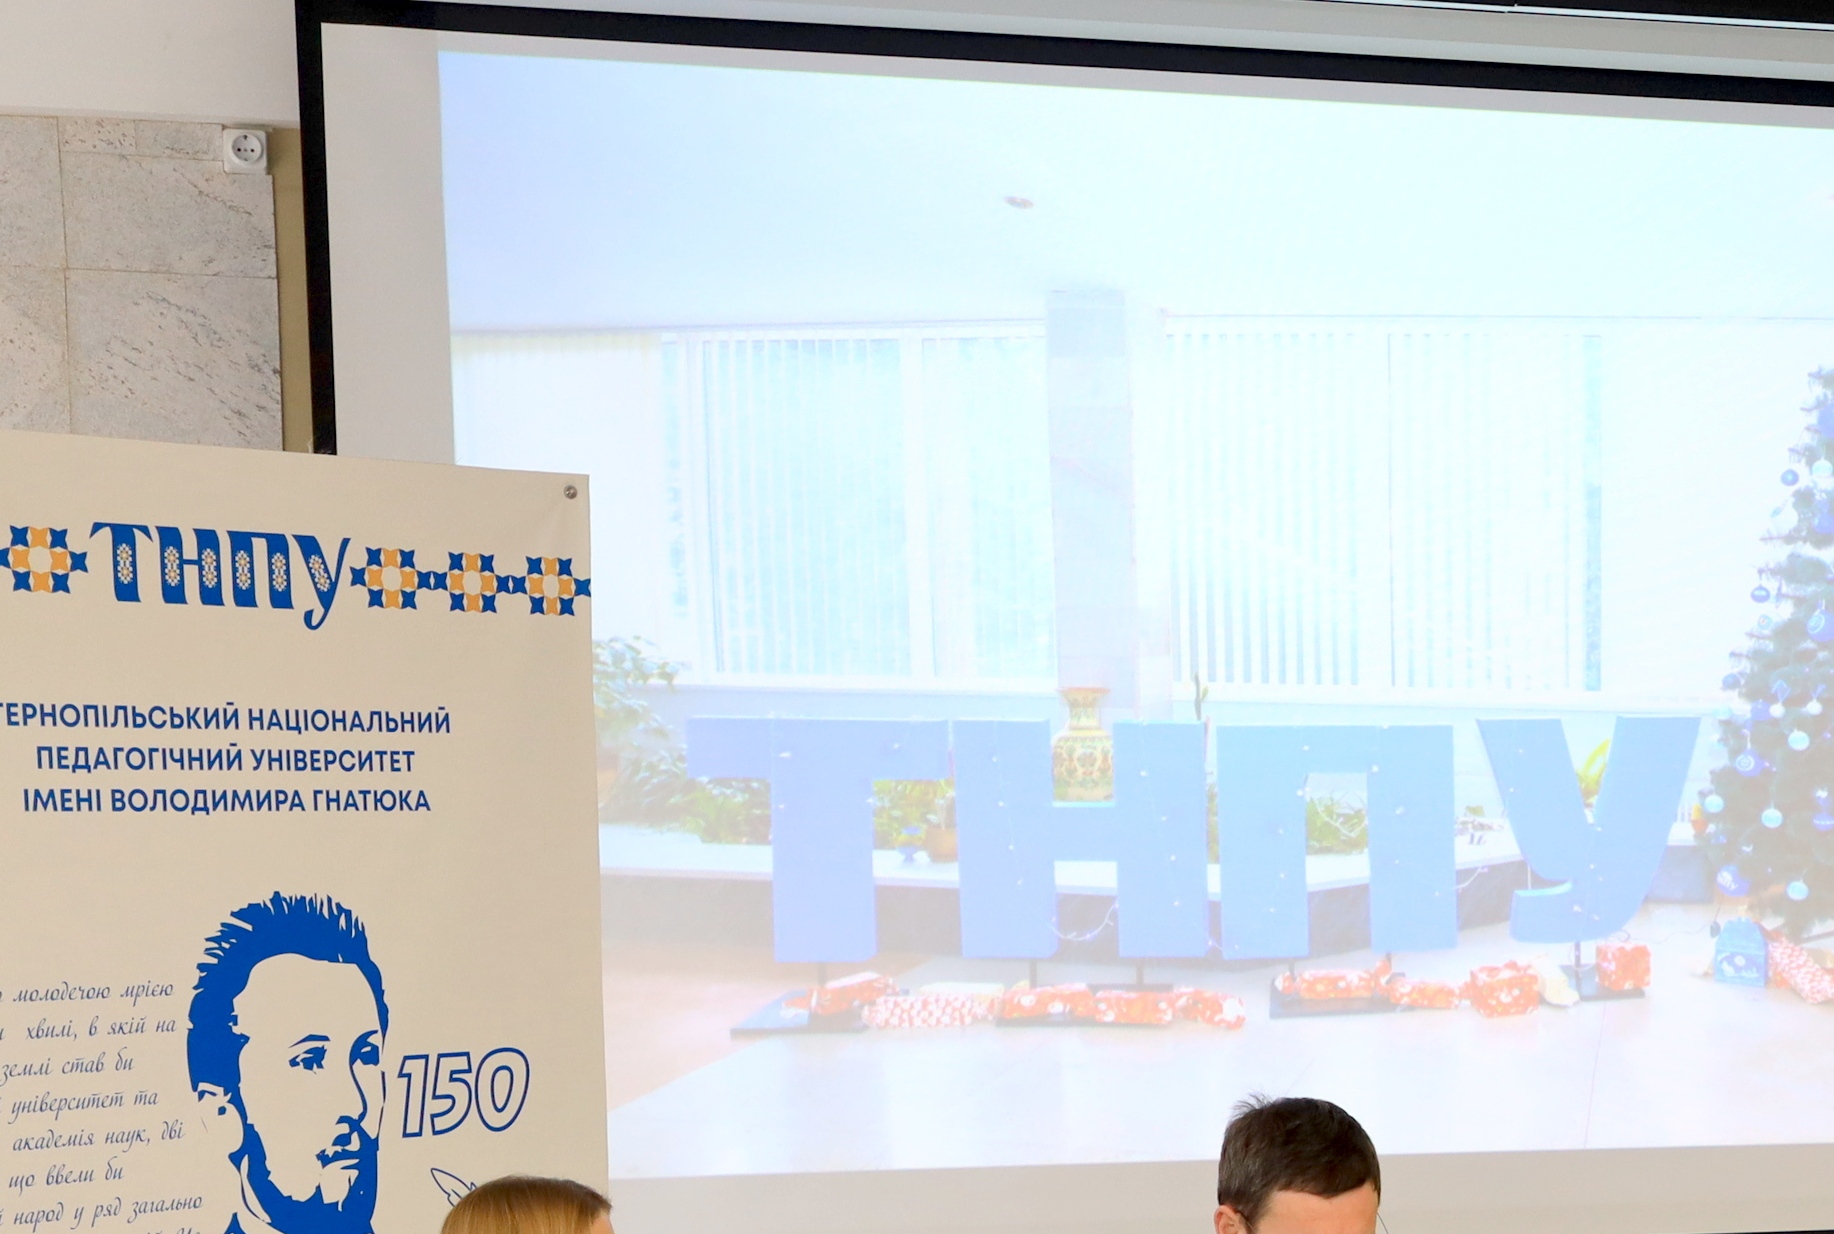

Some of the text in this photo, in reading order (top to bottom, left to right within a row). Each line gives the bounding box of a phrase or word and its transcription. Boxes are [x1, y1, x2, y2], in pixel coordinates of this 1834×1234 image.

[89, 521, 351, 631] ТНПУ
[0, 701, 450, 735] ЕРНОПІЛЬСЬКИЙ НАЦІОНАЛЬНИЙ
[36, 743, 415, 773] ПЕДАГОГІЧНИЙ УНІВЕРСИТЕТ
[23, 788, 431, 815] ІМЕНІ ВОЛОДИМИРА ГНАТЮКА
[685, 715, 1703, 964] ТНПУ
[13, 981, 111, 1002] молодечою
[120, 980, 174, 1007] мрією
[26, 1018, 77, 1041] хвилі,
[88, 1015, 100, 1037] в
[107, 1016, 147, 1036] якій
[155, 1019, 177, 1033] на
[0, 1046, 134, 1087] землі став би
[8, 1091, 125, 1124] університет
[133, 1090, 158, 1105] та
[397, 1047, 530, 1139] 150
[12, 1120, 185, 1152] академія наук, дві
[8, 1156, 124, 1197] що ввели би
[14, 1202, 64, 1233] народ
[70, 1206, 84, 1230] у
[91, 1197, 122, 1227] ряд
[127, 1196, 202, 1224] загально
